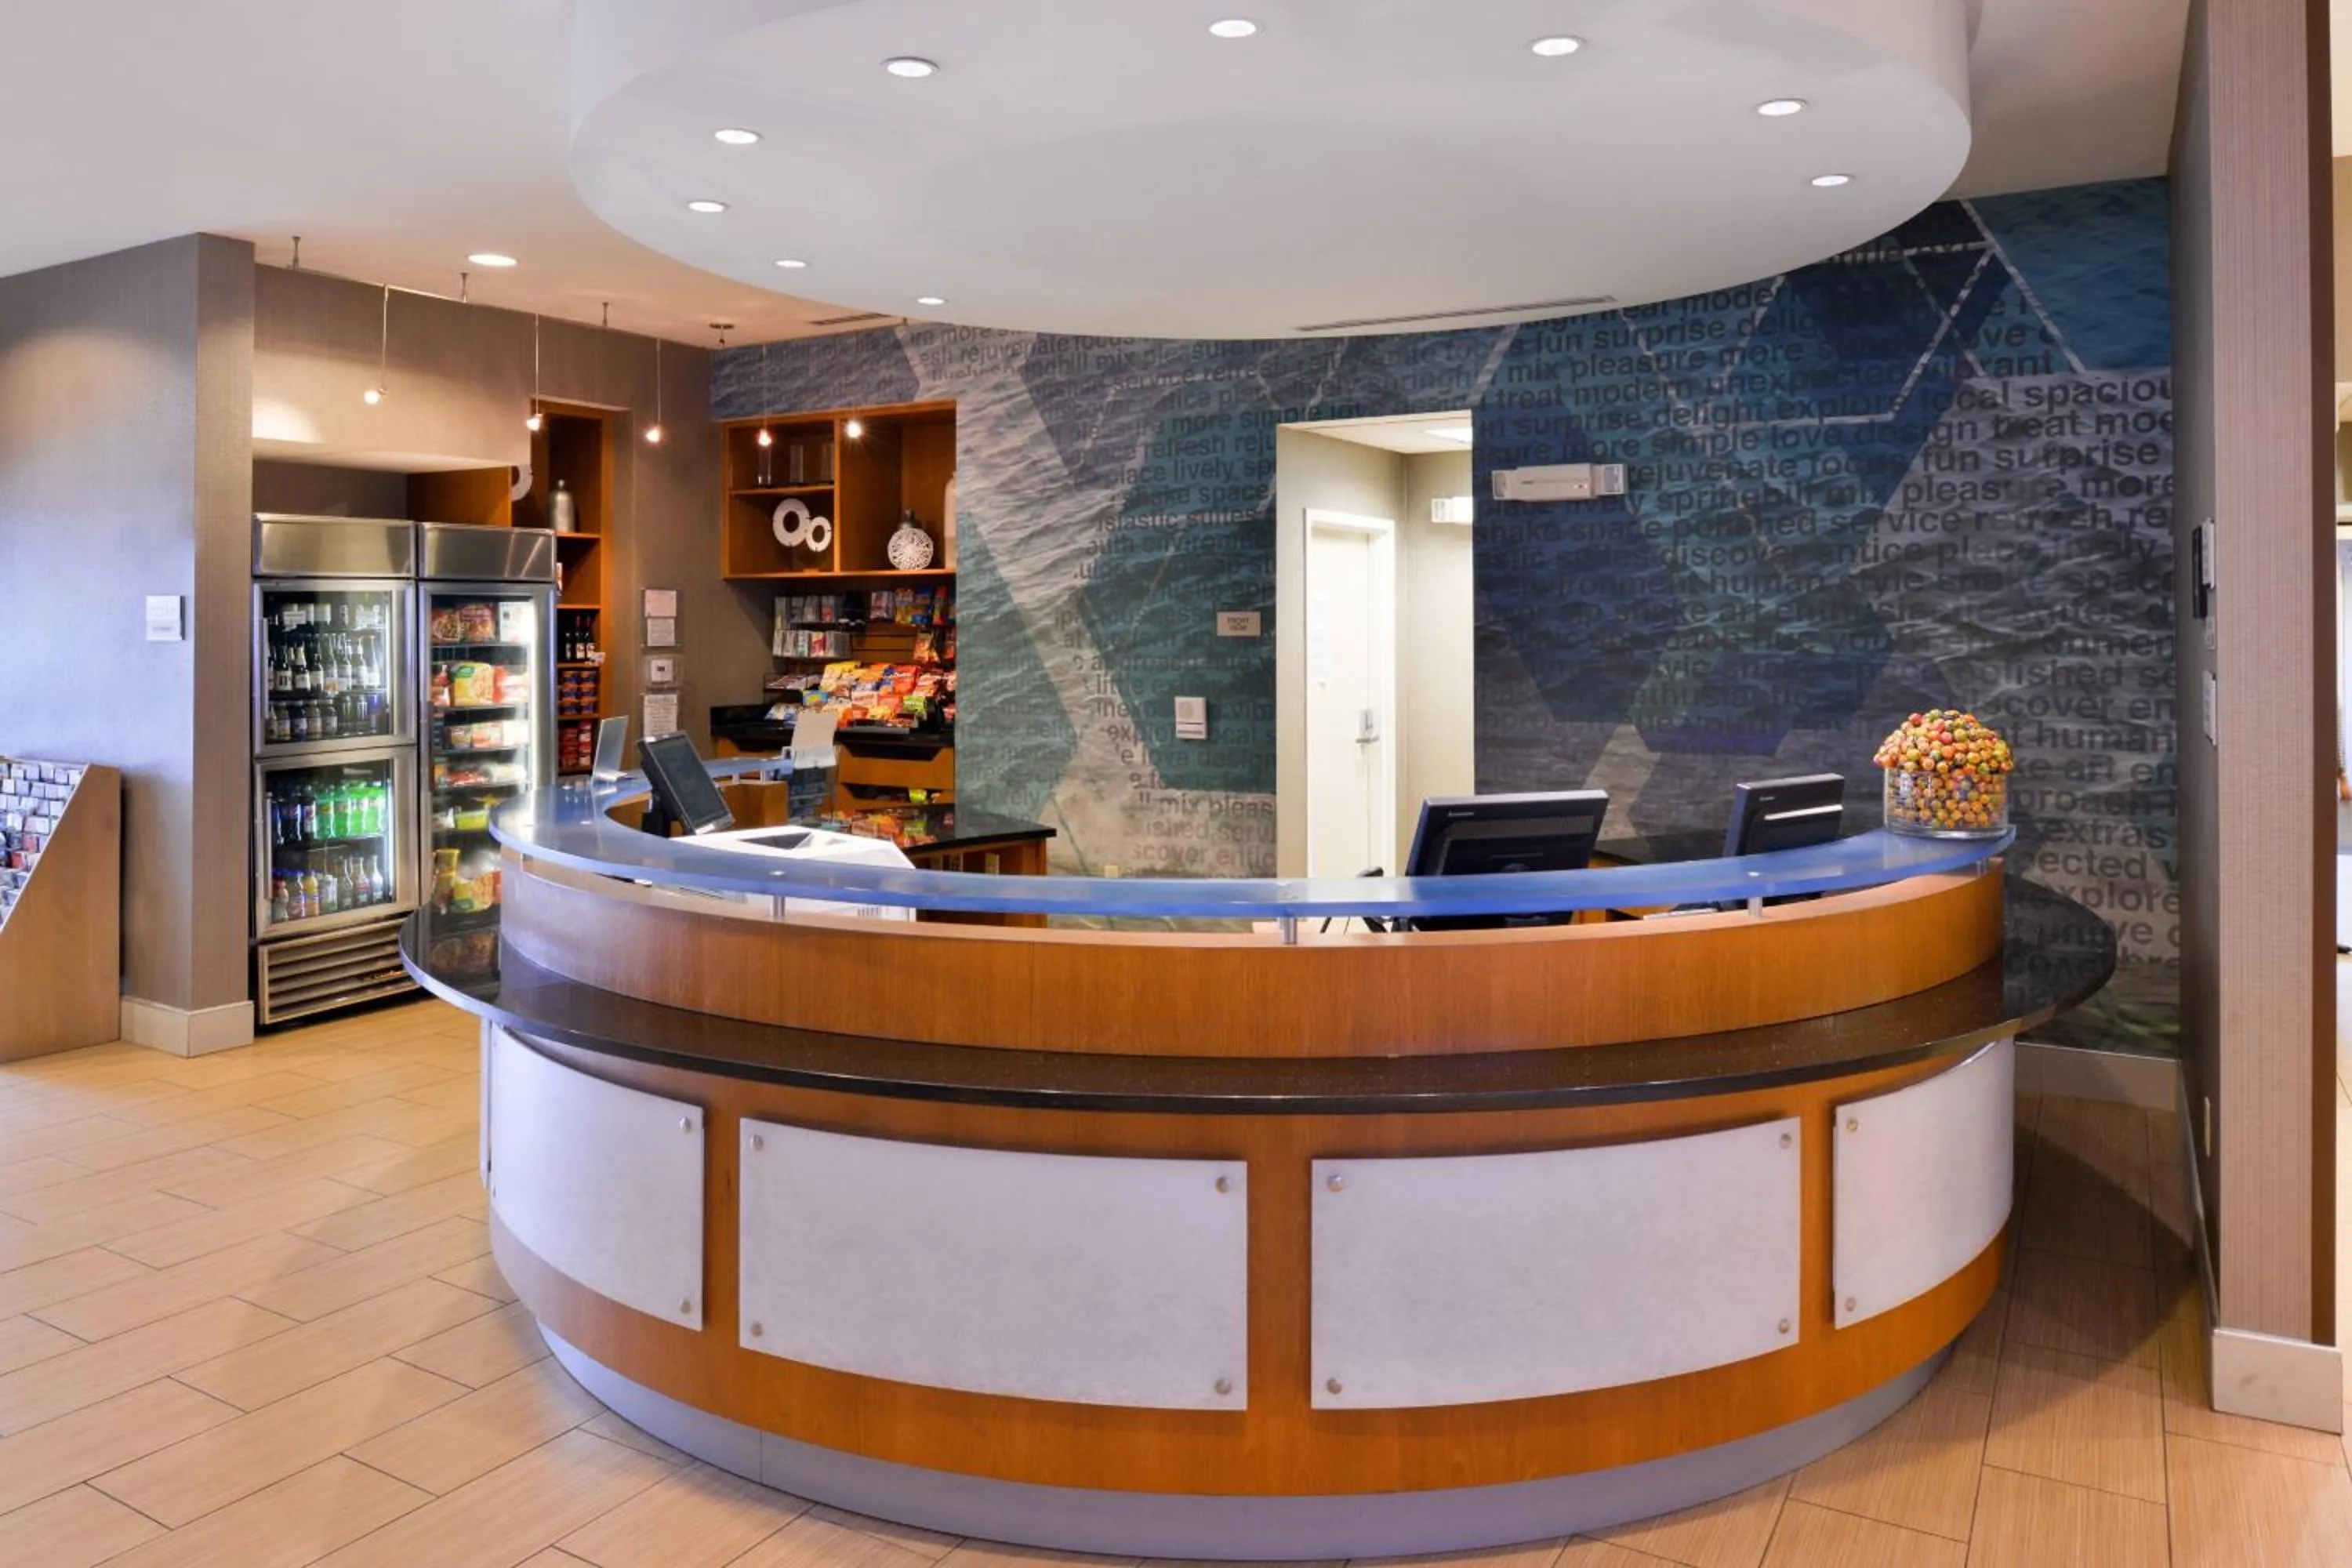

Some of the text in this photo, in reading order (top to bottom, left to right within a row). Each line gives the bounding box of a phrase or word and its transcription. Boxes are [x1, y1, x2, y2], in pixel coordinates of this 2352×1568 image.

[1534, 329, 1584, 355] fun
[1593, 317, 1726, 352] surprise
[1508, 357, 1559, 384] mix
[1570, 343, 1708, 385] pleasure
[1718, 343, 1804, 372] more
[1495, 384, 1565, 411] treat
[1573, 372, 1694, 406] modern
[1171, 412, 1232, 433] more
[1515, 404, 1642, 439] surprise
[1653, 397, 1771, 430] delight
[1563, 434, 1642, 464] more
[1651, 425, 1761, 461] simple
[1770, 423, 1843, 452] love
[1994, 409, 2081, 439] treat
[1174, 456, 1234, 483] lively
[1626, 452, 1798, 491] rejuvenate
[1922, 443, 1981, 472] fun
[1994, 438, 2161, 476] surprise
[1199, 482, 1269, 507] space
[1830, 506, 1961, 535] service
